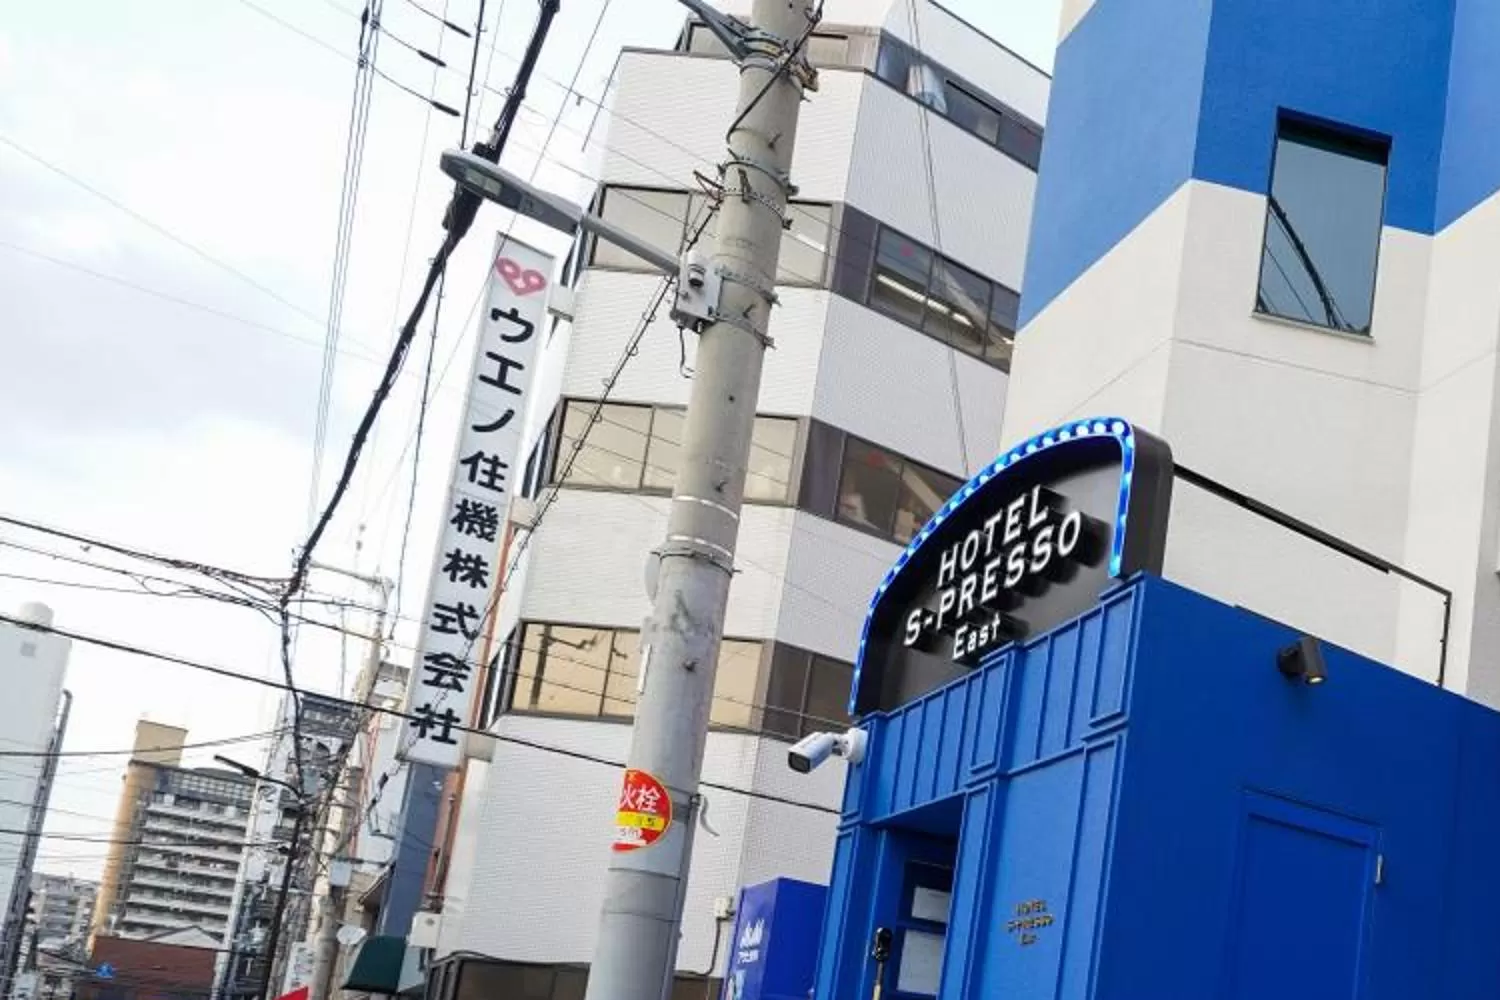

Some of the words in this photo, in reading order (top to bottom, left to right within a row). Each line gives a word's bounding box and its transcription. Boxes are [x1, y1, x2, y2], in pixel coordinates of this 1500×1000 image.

[411, 307, 535, 744] ウエノ住機株式会社
[904, 511, 1081, 646] S-PRESSO
[937, 484, 1049, 587] HOTEL
[953, 612, 1001, 660] East
